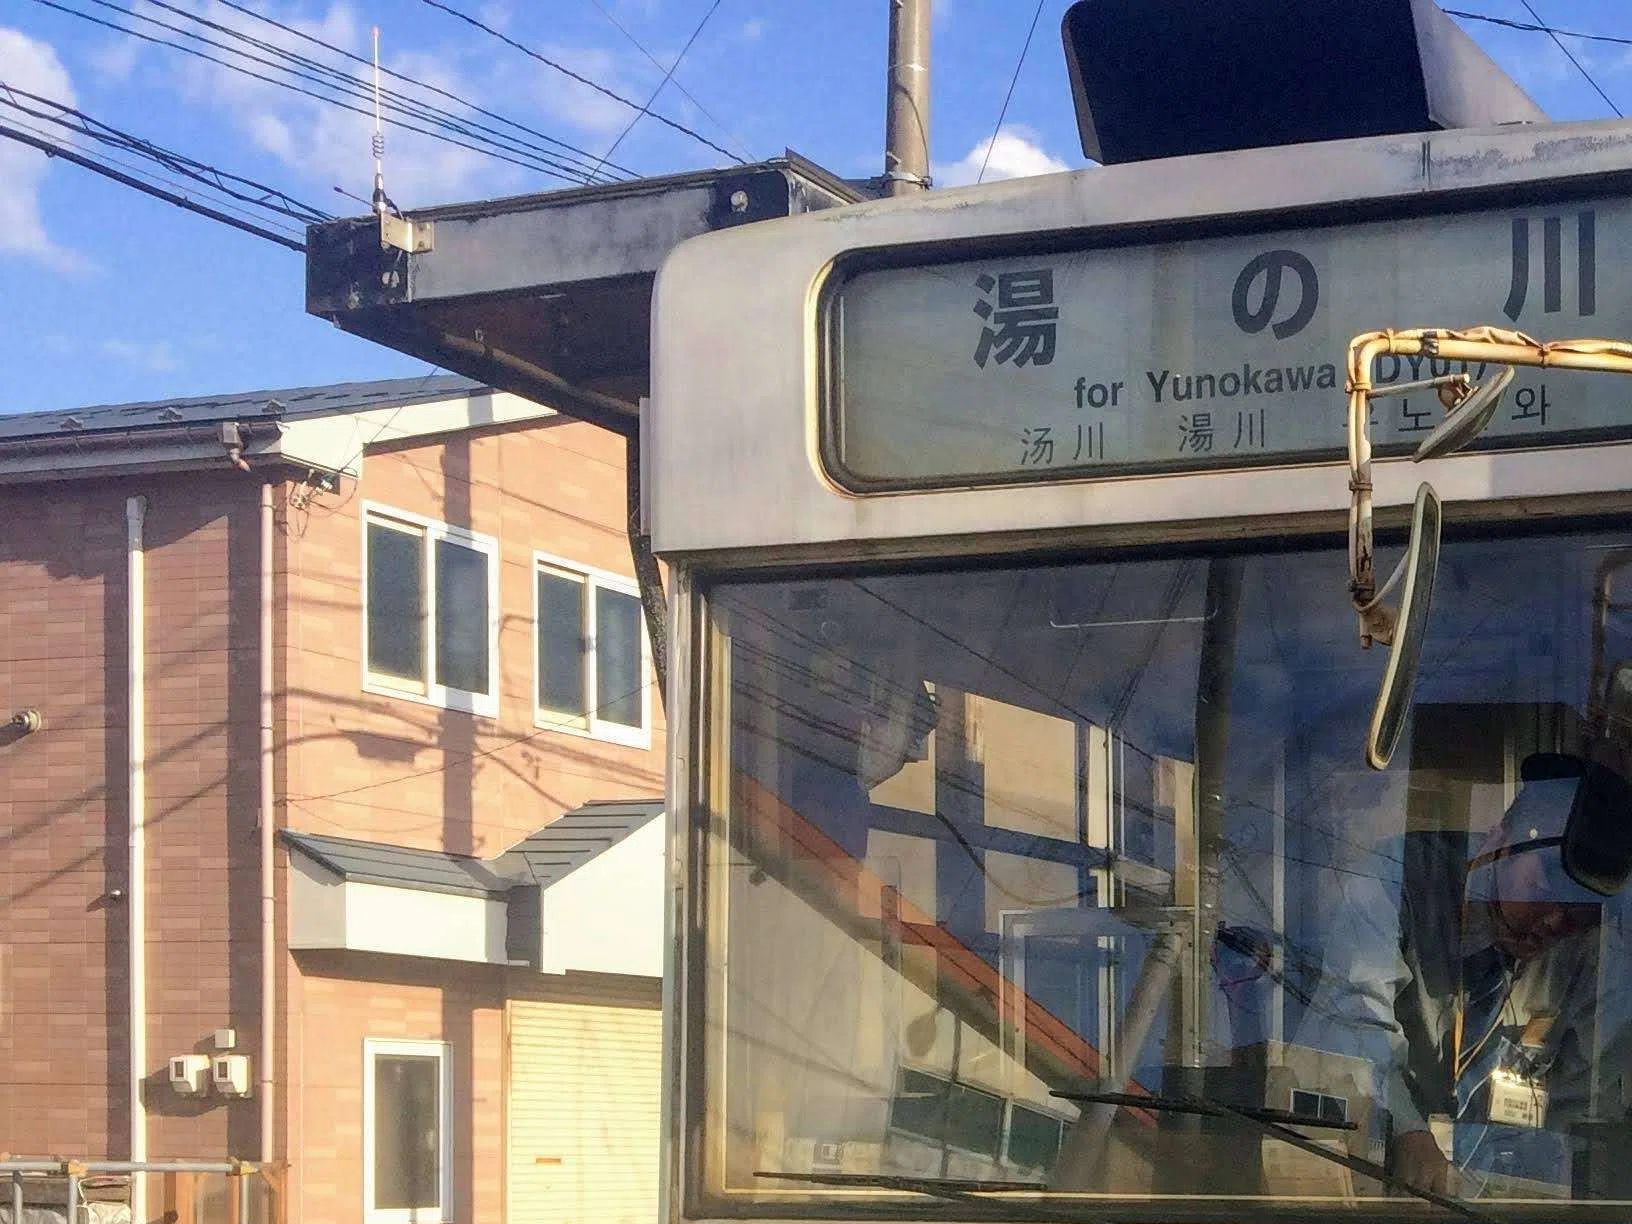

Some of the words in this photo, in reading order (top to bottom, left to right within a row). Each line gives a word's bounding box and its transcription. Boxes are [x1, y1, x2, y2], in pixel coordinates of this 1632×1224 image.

[973, 211, 1596, 369] 湯の川
[1074, 376, 1124, 408] for
[1146, 362, 1336, 402] Yunokawa
[1021, 422, 1104, 465] 汤川
[1179, 408, 1265, 452] 湯川
